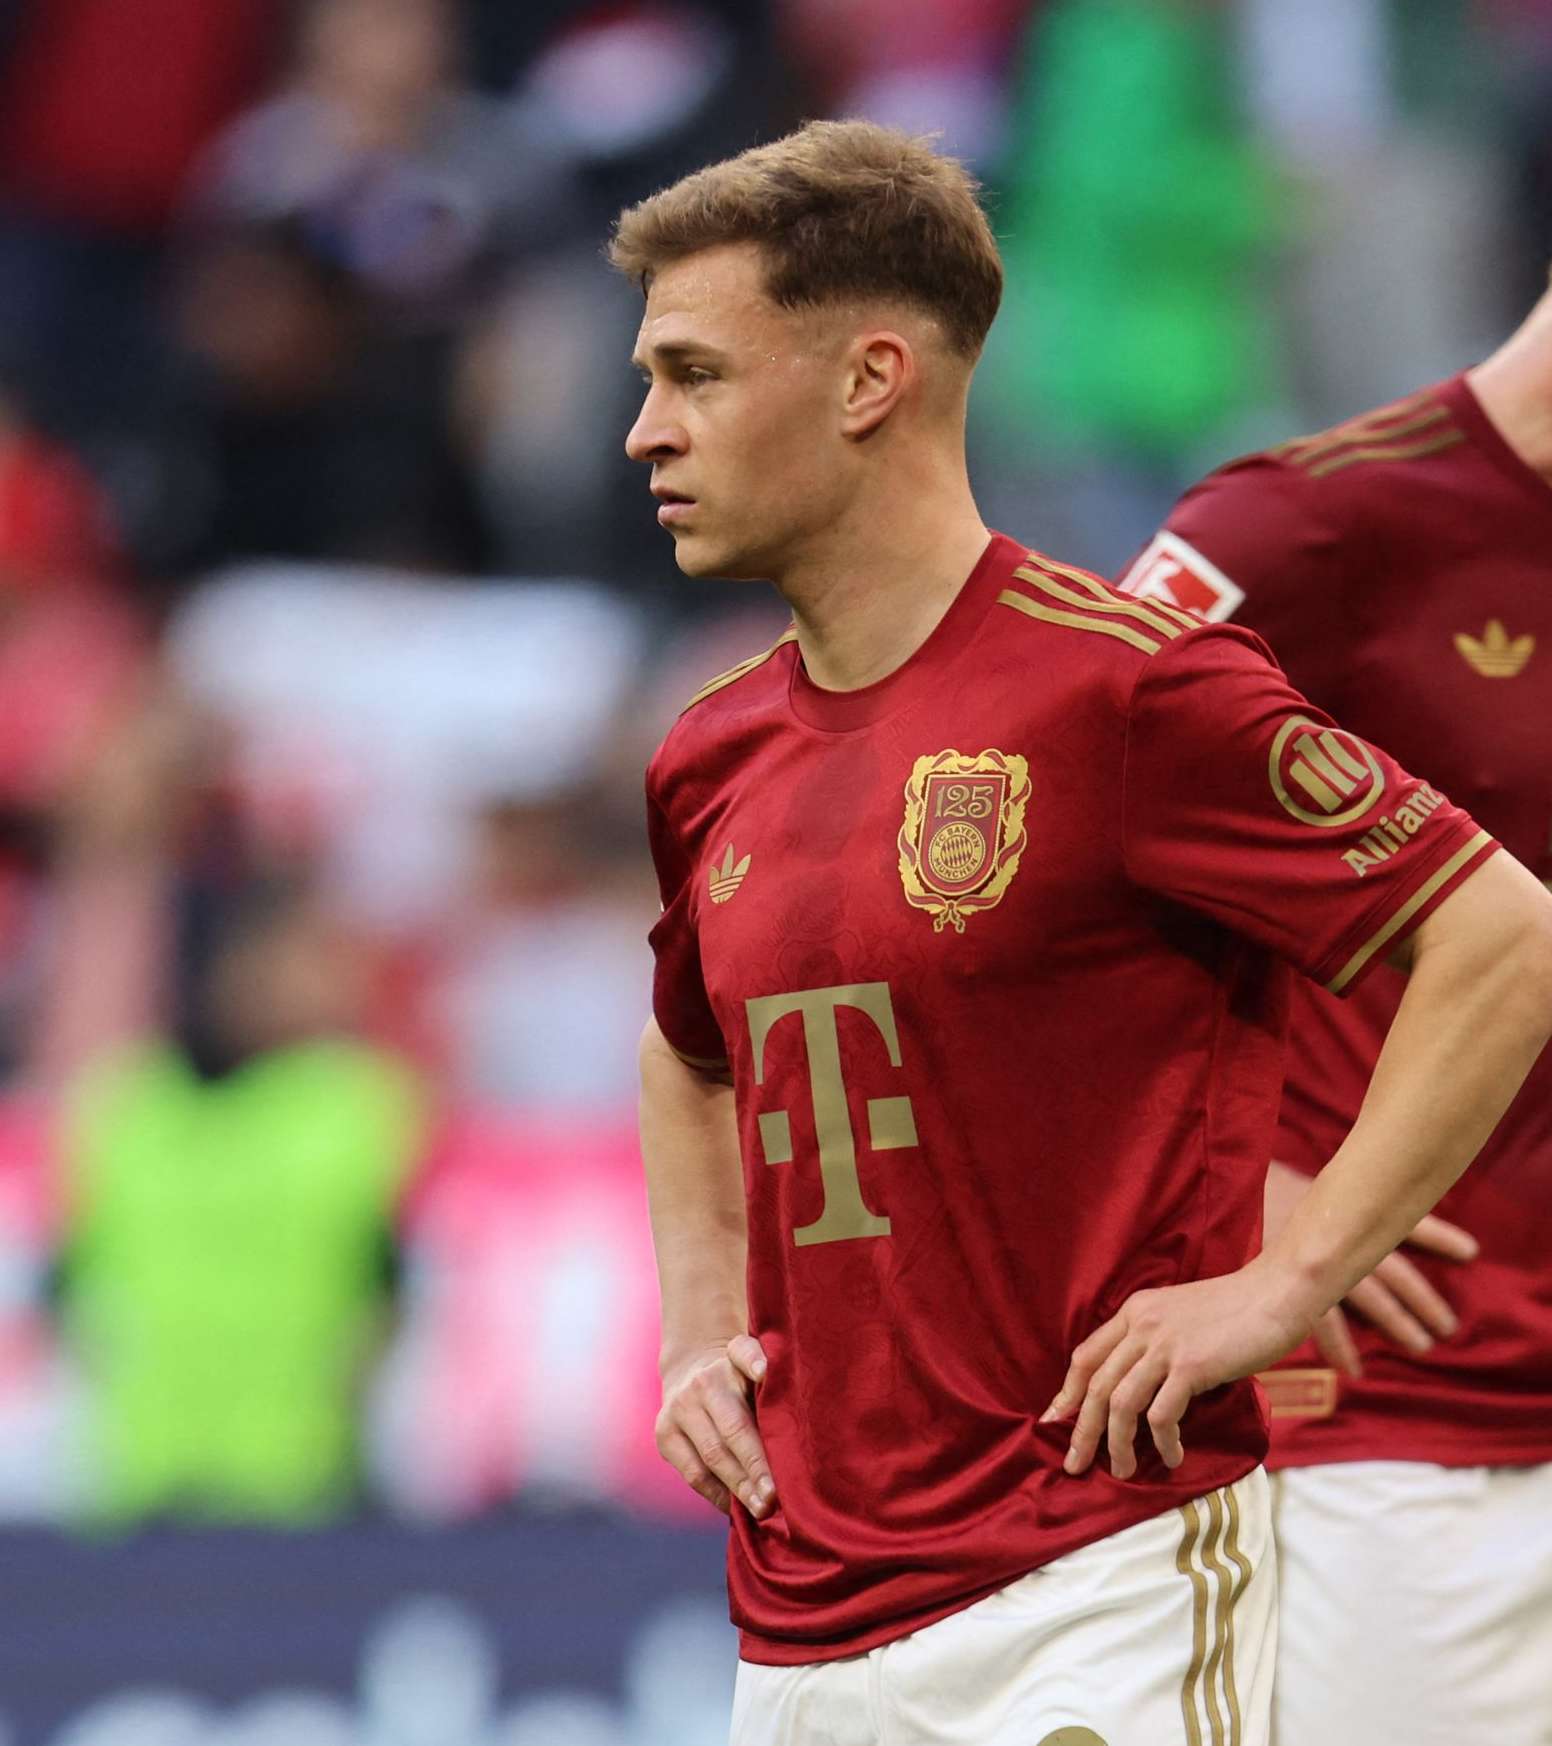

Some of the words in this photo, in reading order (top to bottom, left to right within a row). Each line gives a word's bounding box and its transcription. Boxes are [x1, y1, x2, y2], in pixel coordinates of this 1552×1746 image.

[934, 784, 995, 819] 125
[1340, 783, 1445, 878] Allianz
[946, 825, 981, 849] BAYERN
[745, 981, 903, 1247] T
